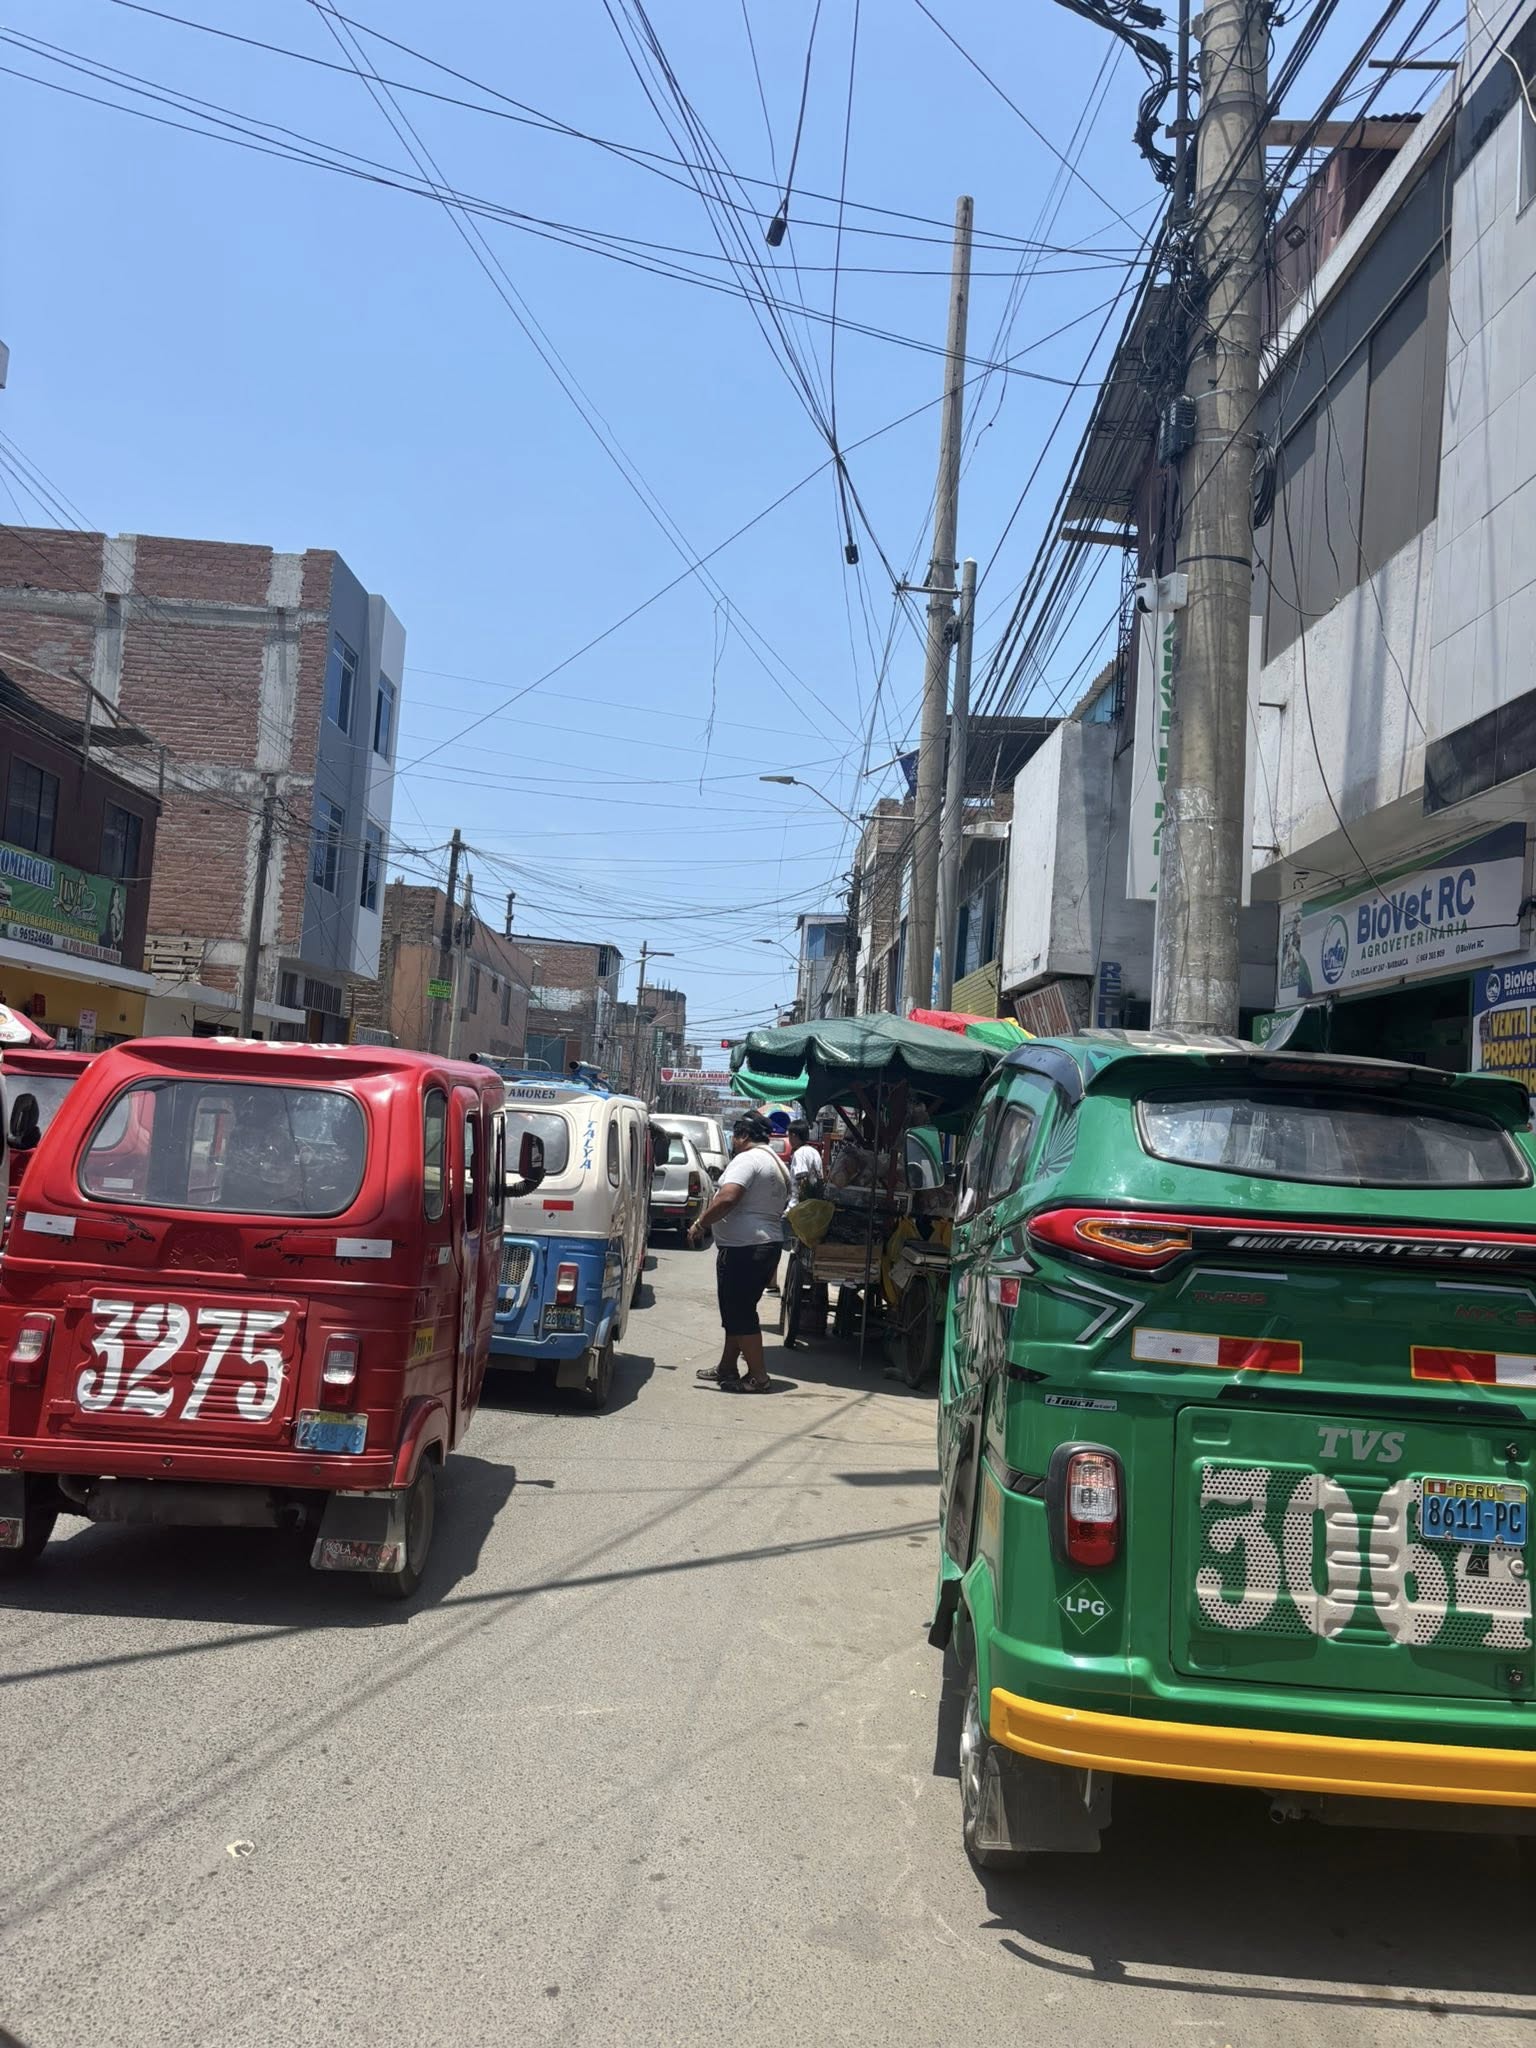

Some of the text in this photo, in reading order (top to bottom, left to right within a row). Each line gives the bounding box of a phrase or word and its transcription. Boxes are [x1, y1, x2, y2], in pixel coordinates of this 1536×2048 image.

[0, 848, 54, 889] OMERCIAL
[1357, 868, 1476, 944] BioVet RC
[1361, 919, 1468, 960] AGROVETERINARIA
[1492, 1008, 1527, 1037] VENTA
[508, 1088, 556, 1100] AMORES
[1279, 1238, 1464, 1258] FIBRATEC
[77, 1299, 289, 1421] 3275
[1318, 1425, 1405, 1463] TVS
[1455, 1482, 1495, 1499] PERU
[1428, 1495, 1522, 1534] 8611-PC
[1066, 1595, 1105, 1616] LPG
